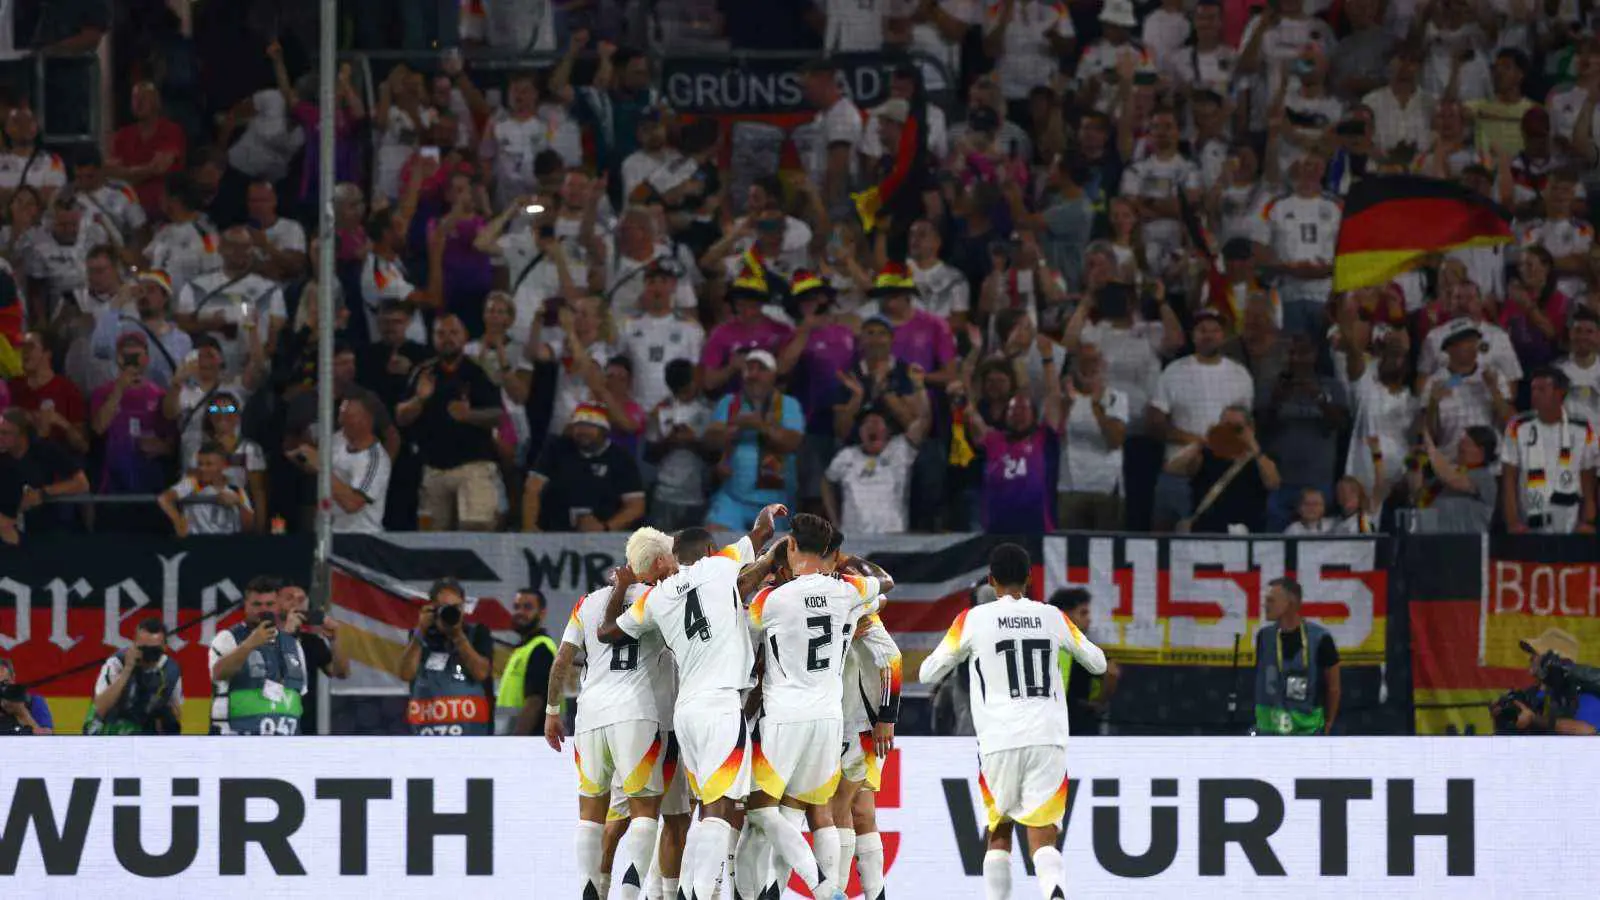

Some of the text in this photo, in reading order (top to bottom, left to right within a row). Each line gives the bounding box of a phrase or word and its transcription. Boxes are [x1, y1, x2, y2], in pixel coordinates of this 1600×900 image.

[667, 64, 898, 107] GRÜNSAD
[523, 548, 613, 594] WIR
[684, 587, 712, 641] 4
[804, 596, 827, 608] KOCH
[998, 617, 1042, 629] MUSIALA
[806, 615, 832, 671] 2
[995, 639, 1051, 698] 10
[407, 699, 476, 722] PHOTO
[0, 778, 494, 877] WÜRTH
[941, 778, 1475, 877] WÜRTH
